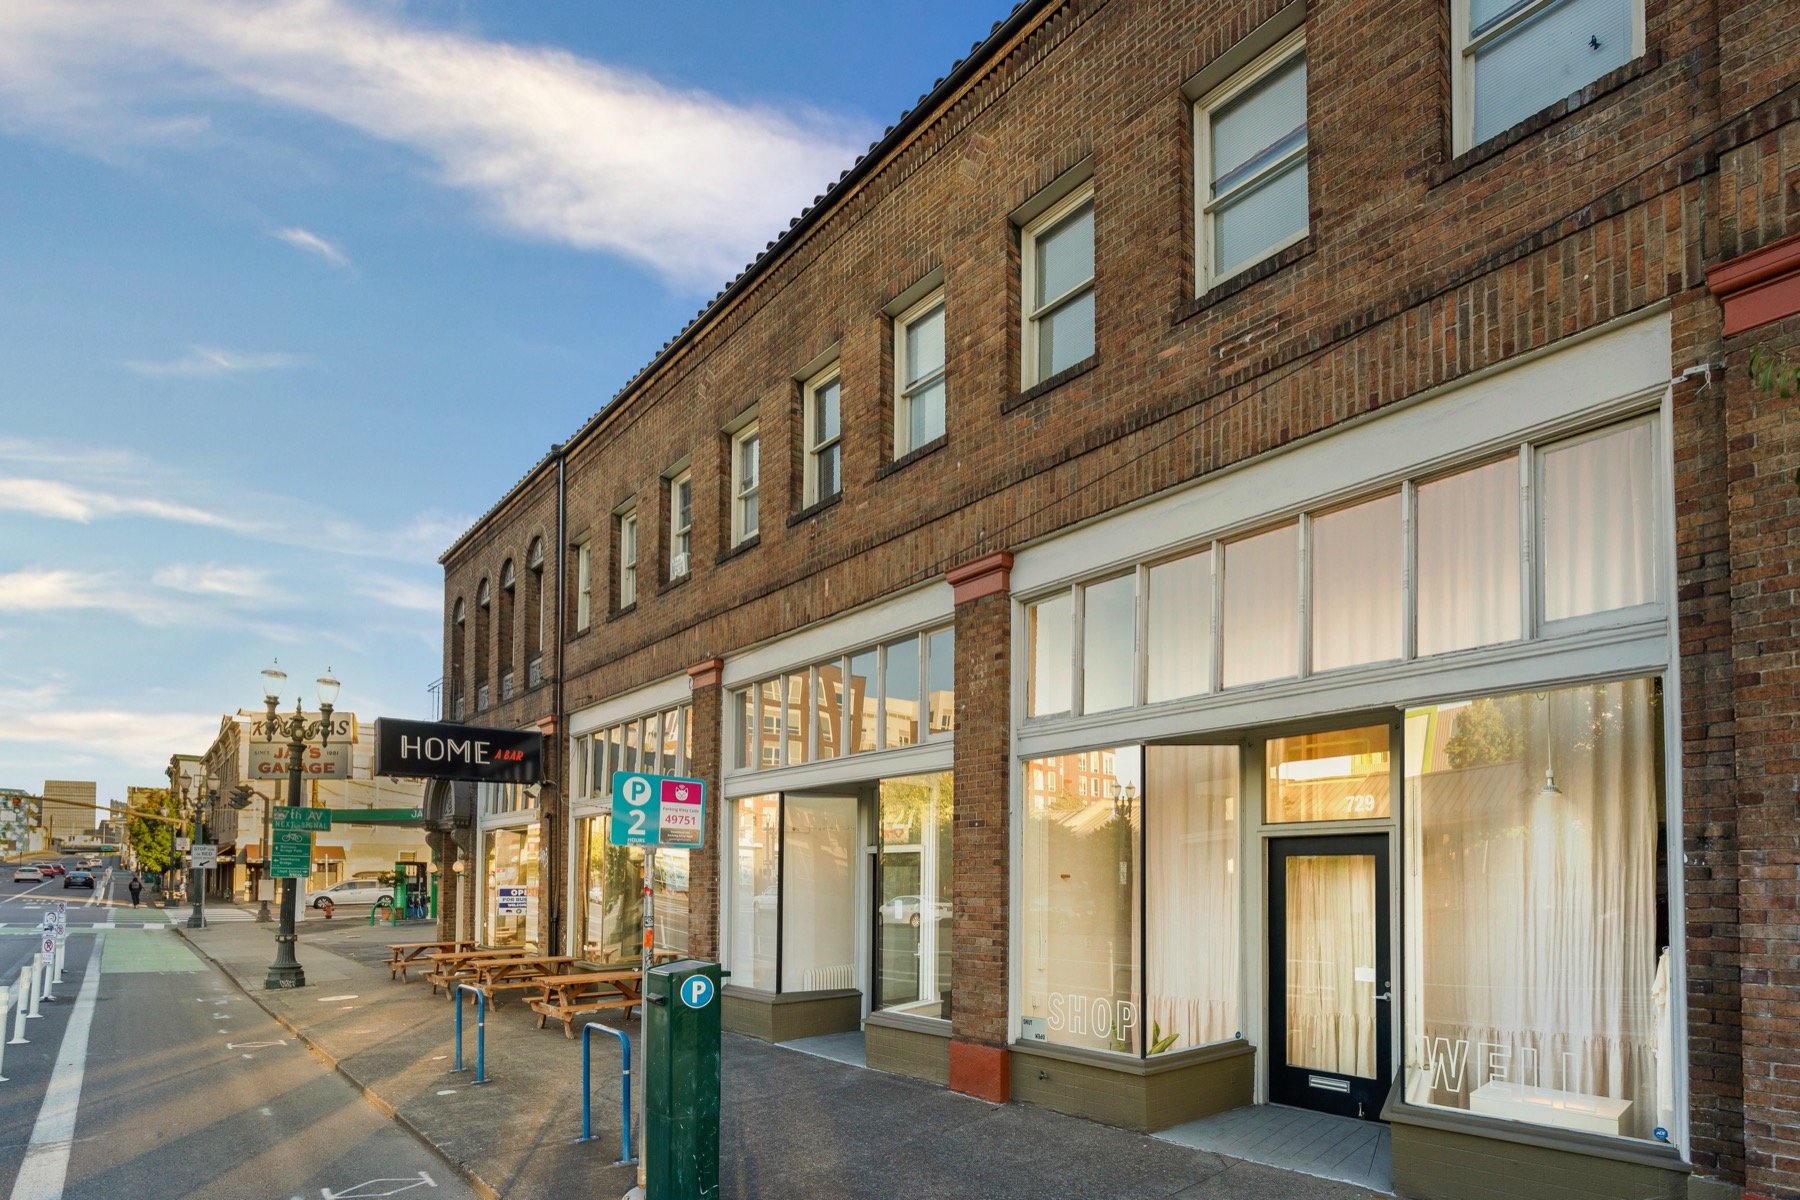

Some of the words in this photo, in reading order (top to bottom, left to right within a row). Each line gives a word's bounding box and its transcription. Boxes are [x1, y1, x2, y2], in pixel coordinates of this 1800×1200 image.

[401, 735, 490, 765] HOME
[494, 749, 502, 760] A
[504, 750, 524, 762] BAR
[631, 781, 646, 801] P
[1344, 795, 1376, 813] 729
[627, 809, 646, 835] 2
[664, 814, 696, 826] 49751
[692, 980, 706, 1004] P
[1047, 991, 1138, 1042] SHOP
[1415, 1034, 1598, 1113] WELL
